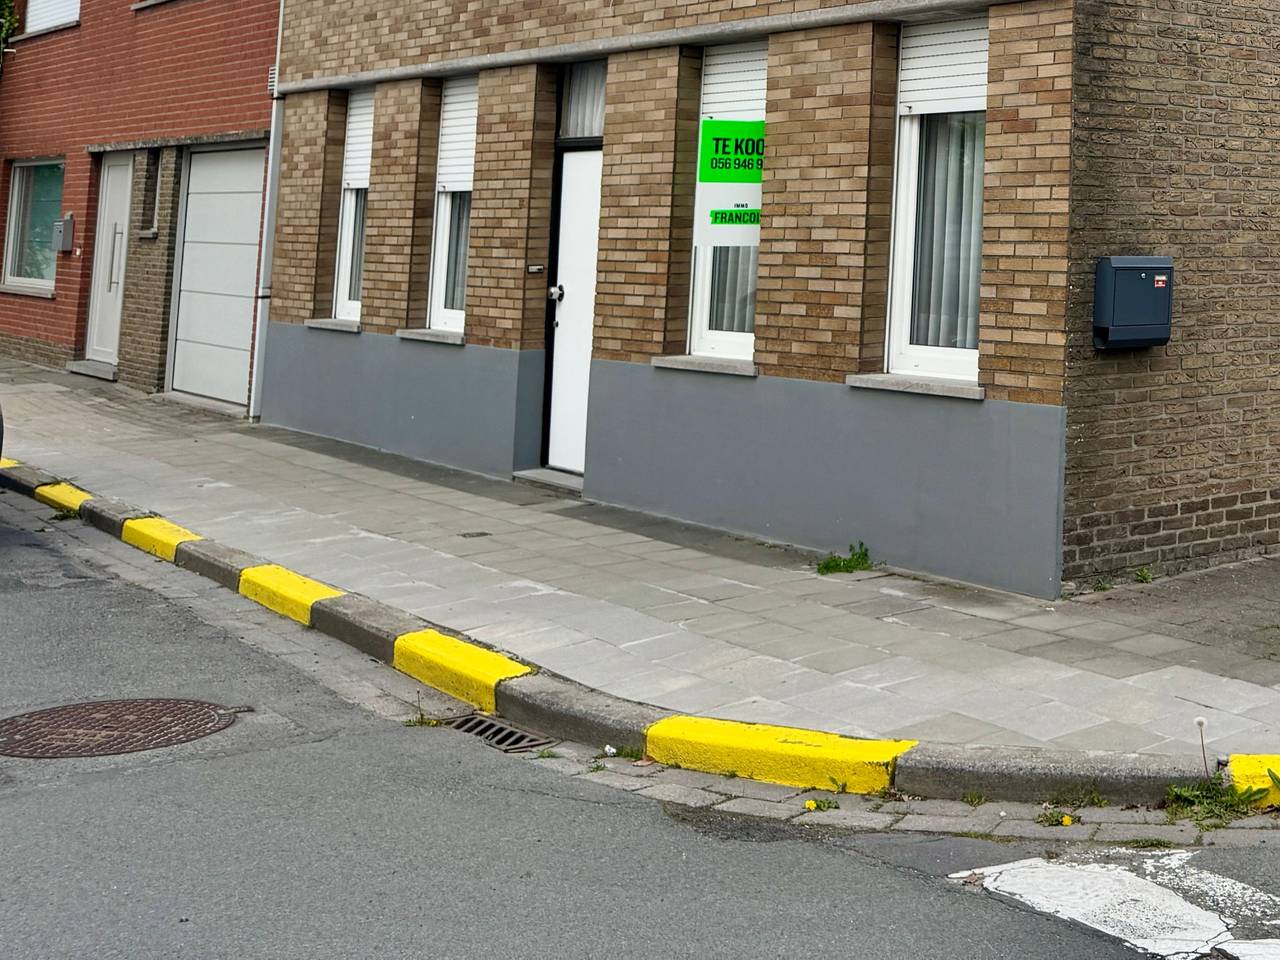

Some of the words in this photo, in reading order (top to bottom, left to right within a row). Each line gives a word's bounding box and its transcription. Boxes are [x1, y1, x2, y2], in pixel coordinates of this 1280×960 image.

[712, 138, 731, 155] TE
[734, 138, 764, 155] KOO
[711, 157, 732, 170] 056
[733, 157, 755, 170] 946
[714, 211, 760, 224] FRANCOI
